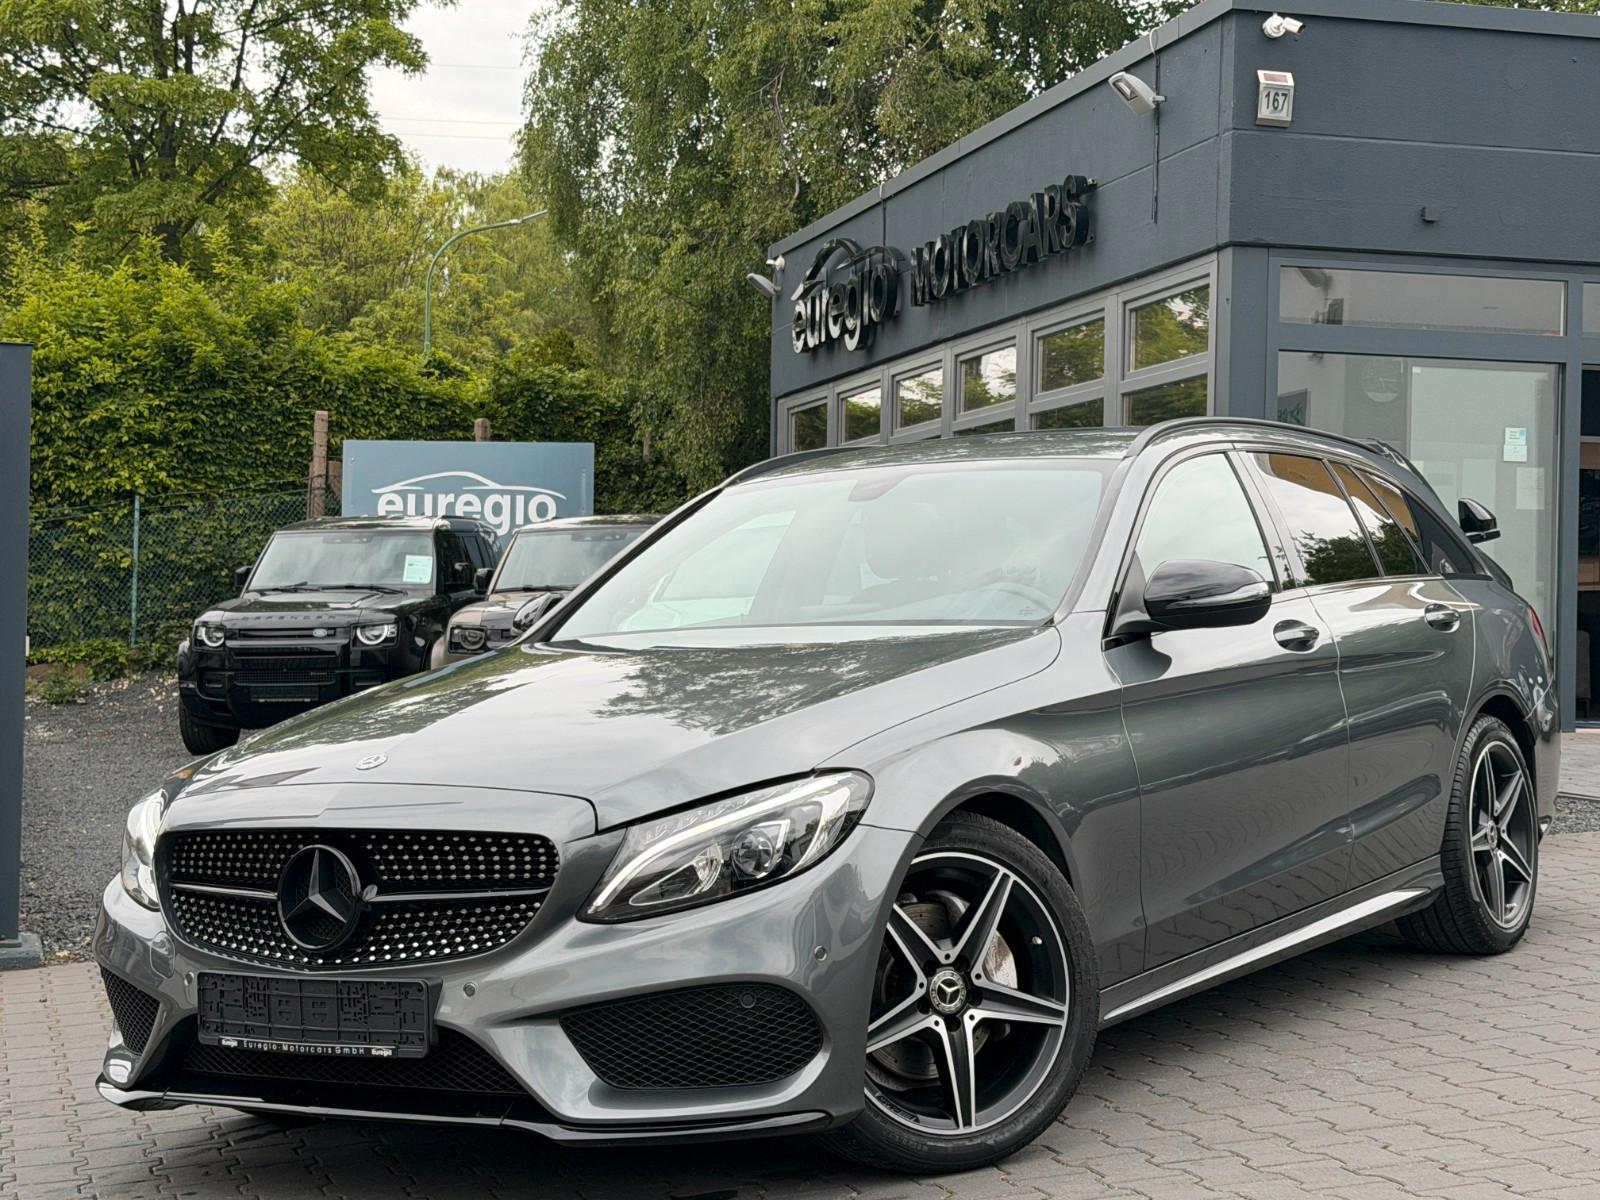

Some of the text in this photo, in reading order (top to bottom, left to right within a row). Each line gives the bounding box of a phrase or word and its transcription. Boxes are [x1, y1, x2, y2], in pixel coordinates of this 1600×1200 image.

[1264, 90, 1289, 111] 167
[791, 174, 1091, 354] euregio MOTORCARS
[377, 492, 557, 536] euregio
